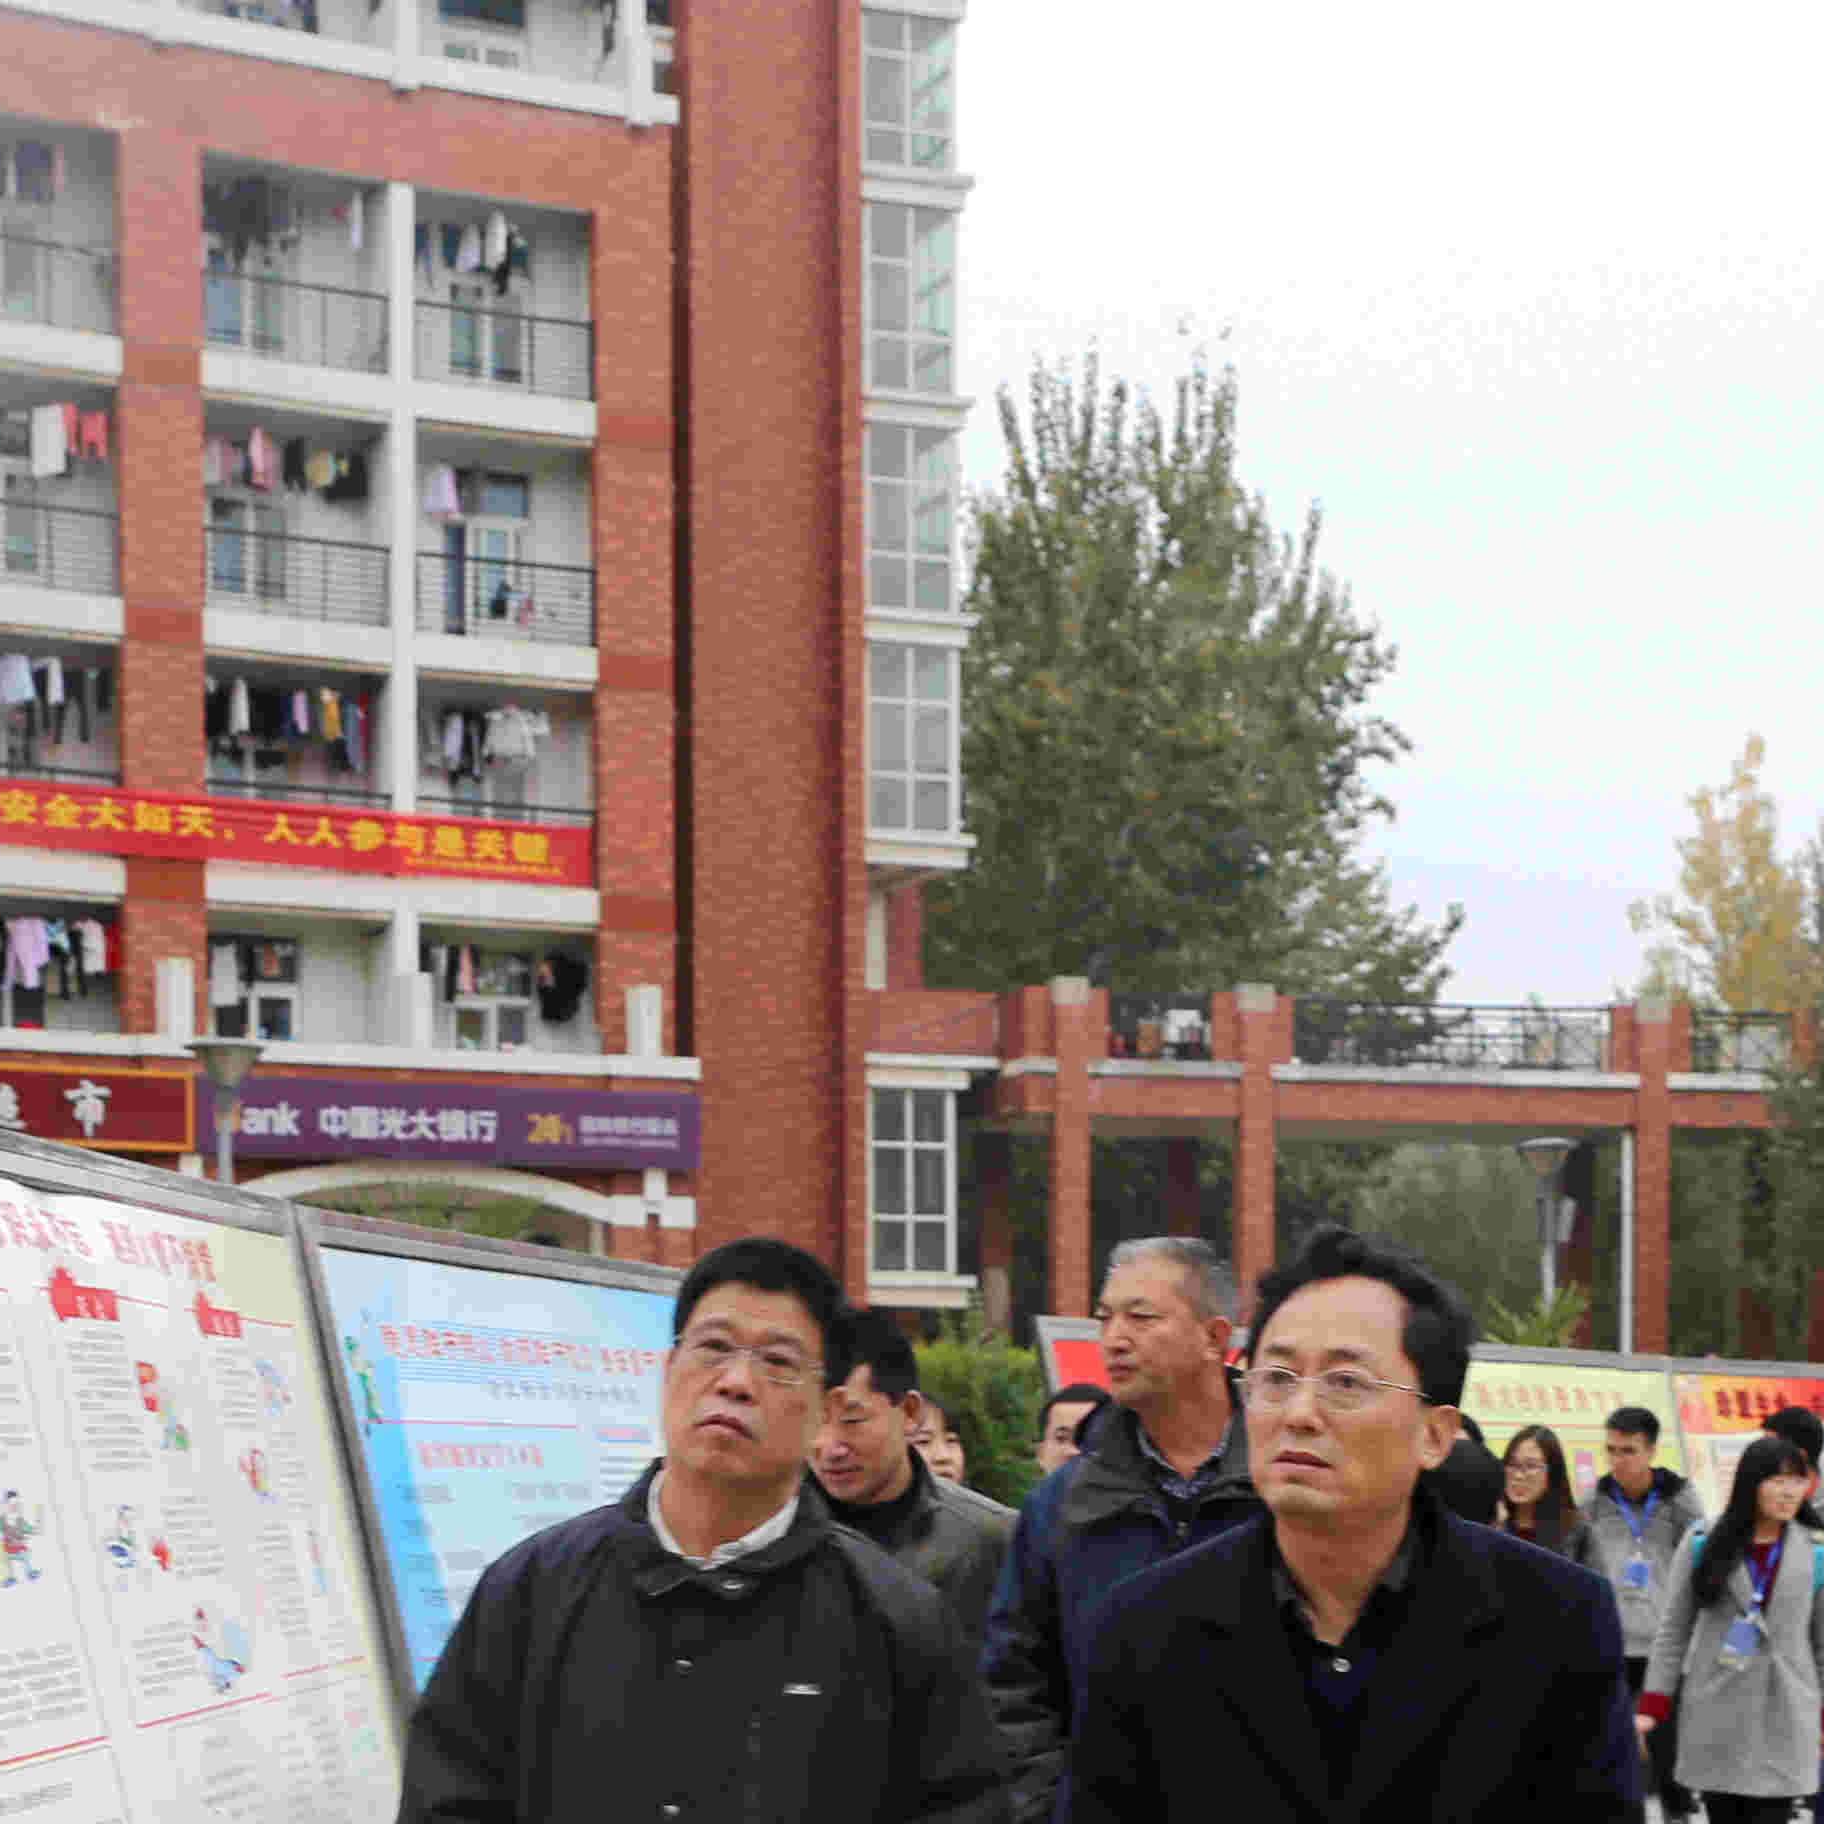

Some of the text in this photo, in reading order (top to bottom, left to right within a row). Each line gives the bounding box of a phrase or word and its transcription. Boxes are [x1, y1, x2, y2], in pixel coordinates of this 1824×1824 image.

[319, 1105, 498, 1144] 中国光大银行
